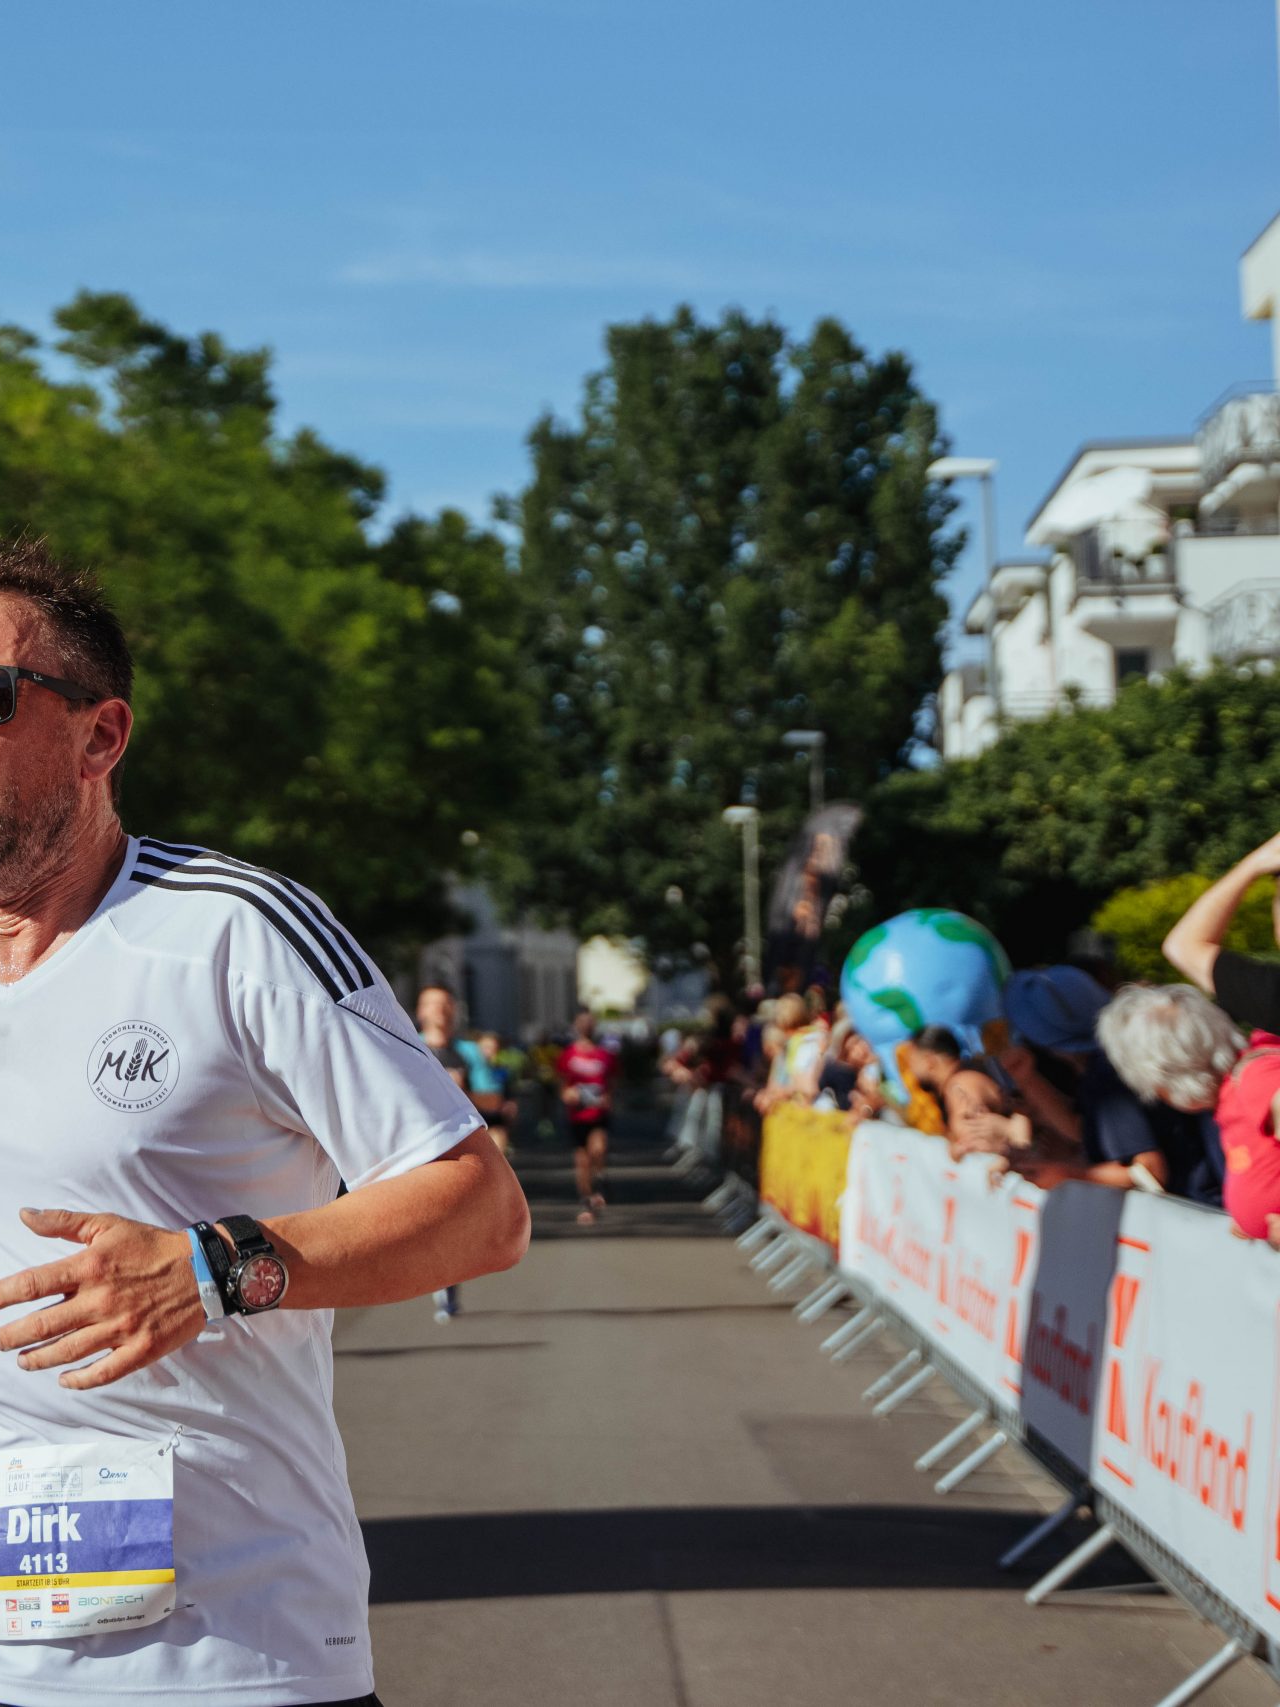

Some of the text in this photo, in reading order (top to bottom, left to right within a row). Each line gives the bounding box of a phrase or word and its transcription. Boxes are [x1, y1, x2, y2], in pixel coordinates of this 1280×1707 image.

[8, 1481, 31, 1493] LAUF
[6, 1505, 82, 1545] Dirk
[19, 1552, 68, 1574] 4113
[16, 1578, 43, 1587] STARTZEIT
[78, 1594, 144, 1606] BIONTECH
